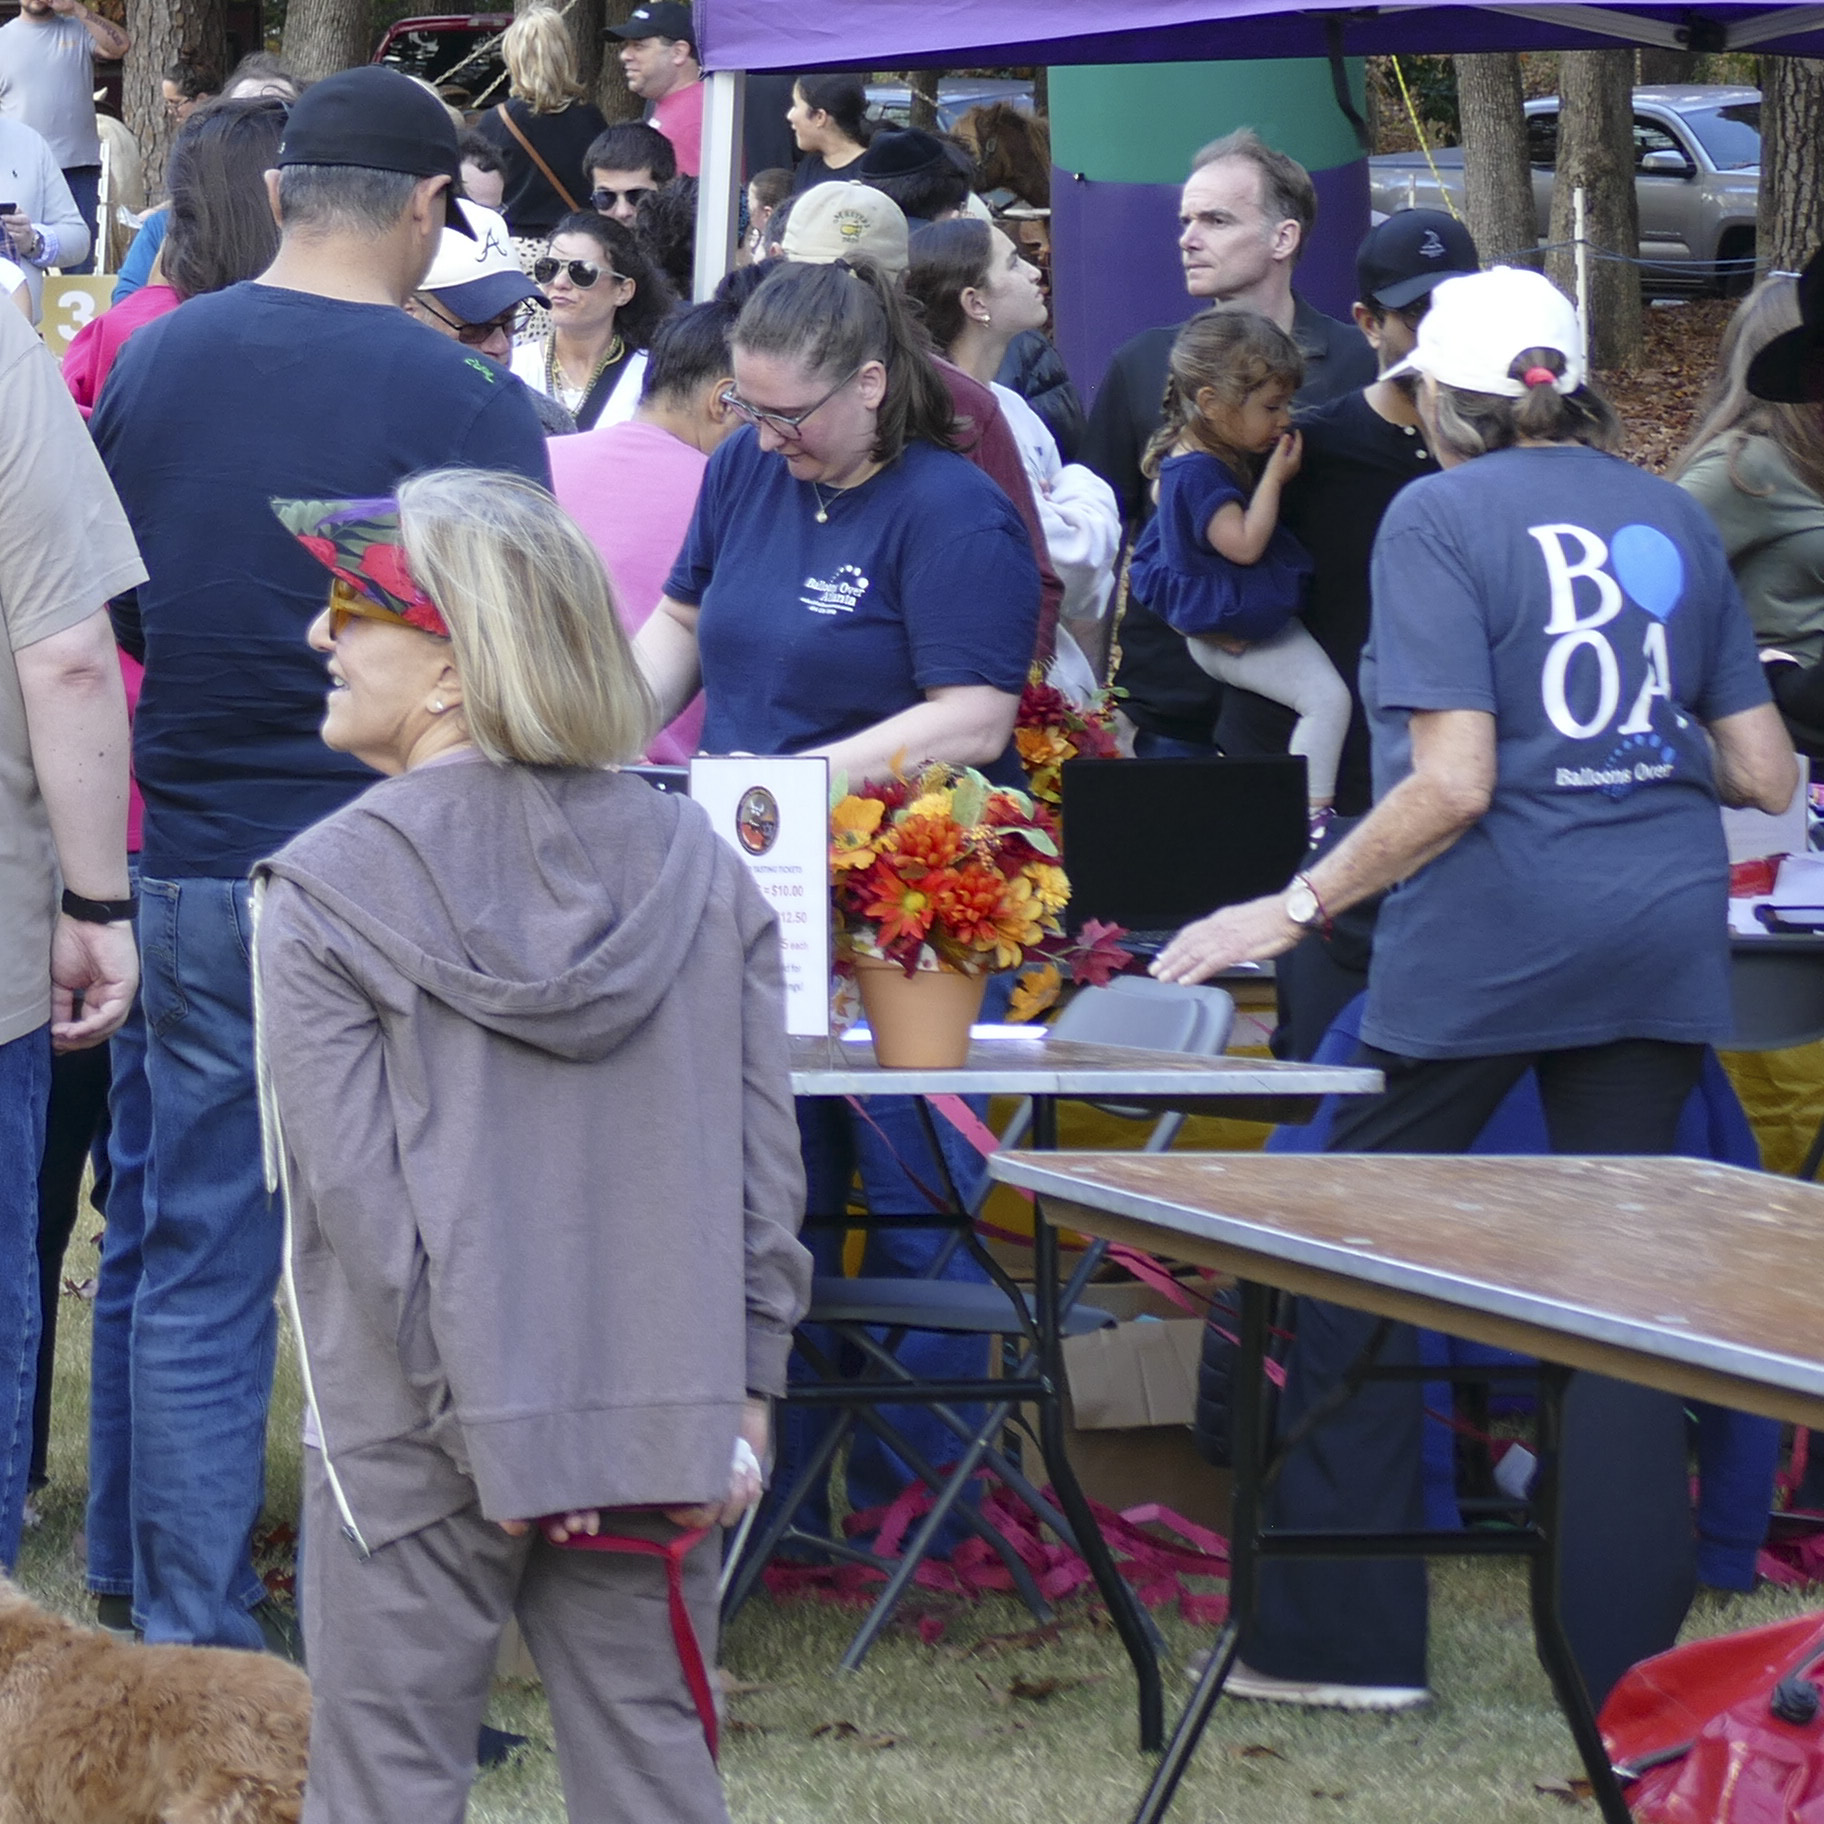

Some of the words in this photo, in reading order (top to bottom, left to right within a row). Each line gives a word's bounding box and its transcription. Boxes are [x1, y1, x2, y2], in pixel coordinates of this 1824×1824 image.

[475, 228, 507, 262] A
[1555, 767, 1632, 787] Balloons
[1634, 762, 1674, 782] Over
[771, 885, 804, 897] $10.00
[780, 911, 808, 924] 12.50
